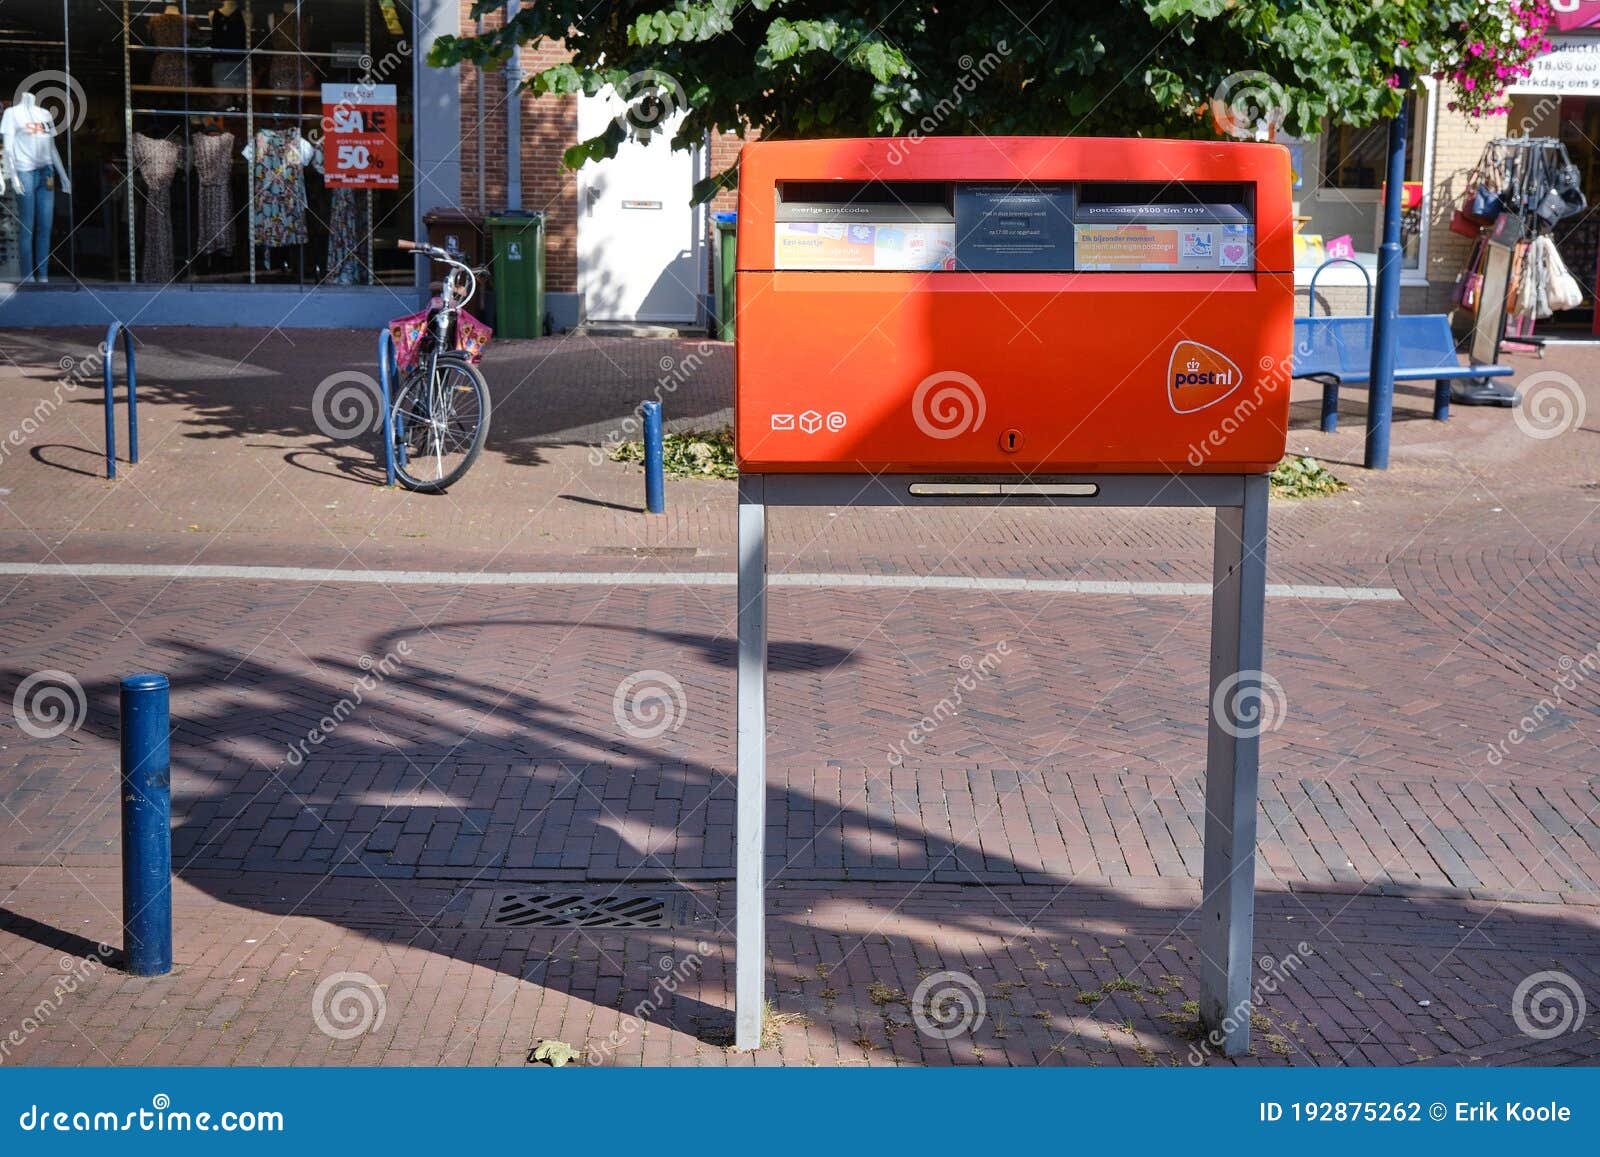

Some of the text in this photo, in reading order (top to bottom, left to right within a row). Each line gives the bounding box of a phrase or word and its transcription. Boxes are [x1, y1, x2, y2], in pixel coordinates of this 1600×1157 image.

[333, 110, 385, 133] SALE
[337, 145, 385, 170] 50%
[1175, 368, 1232, 389] postnl
